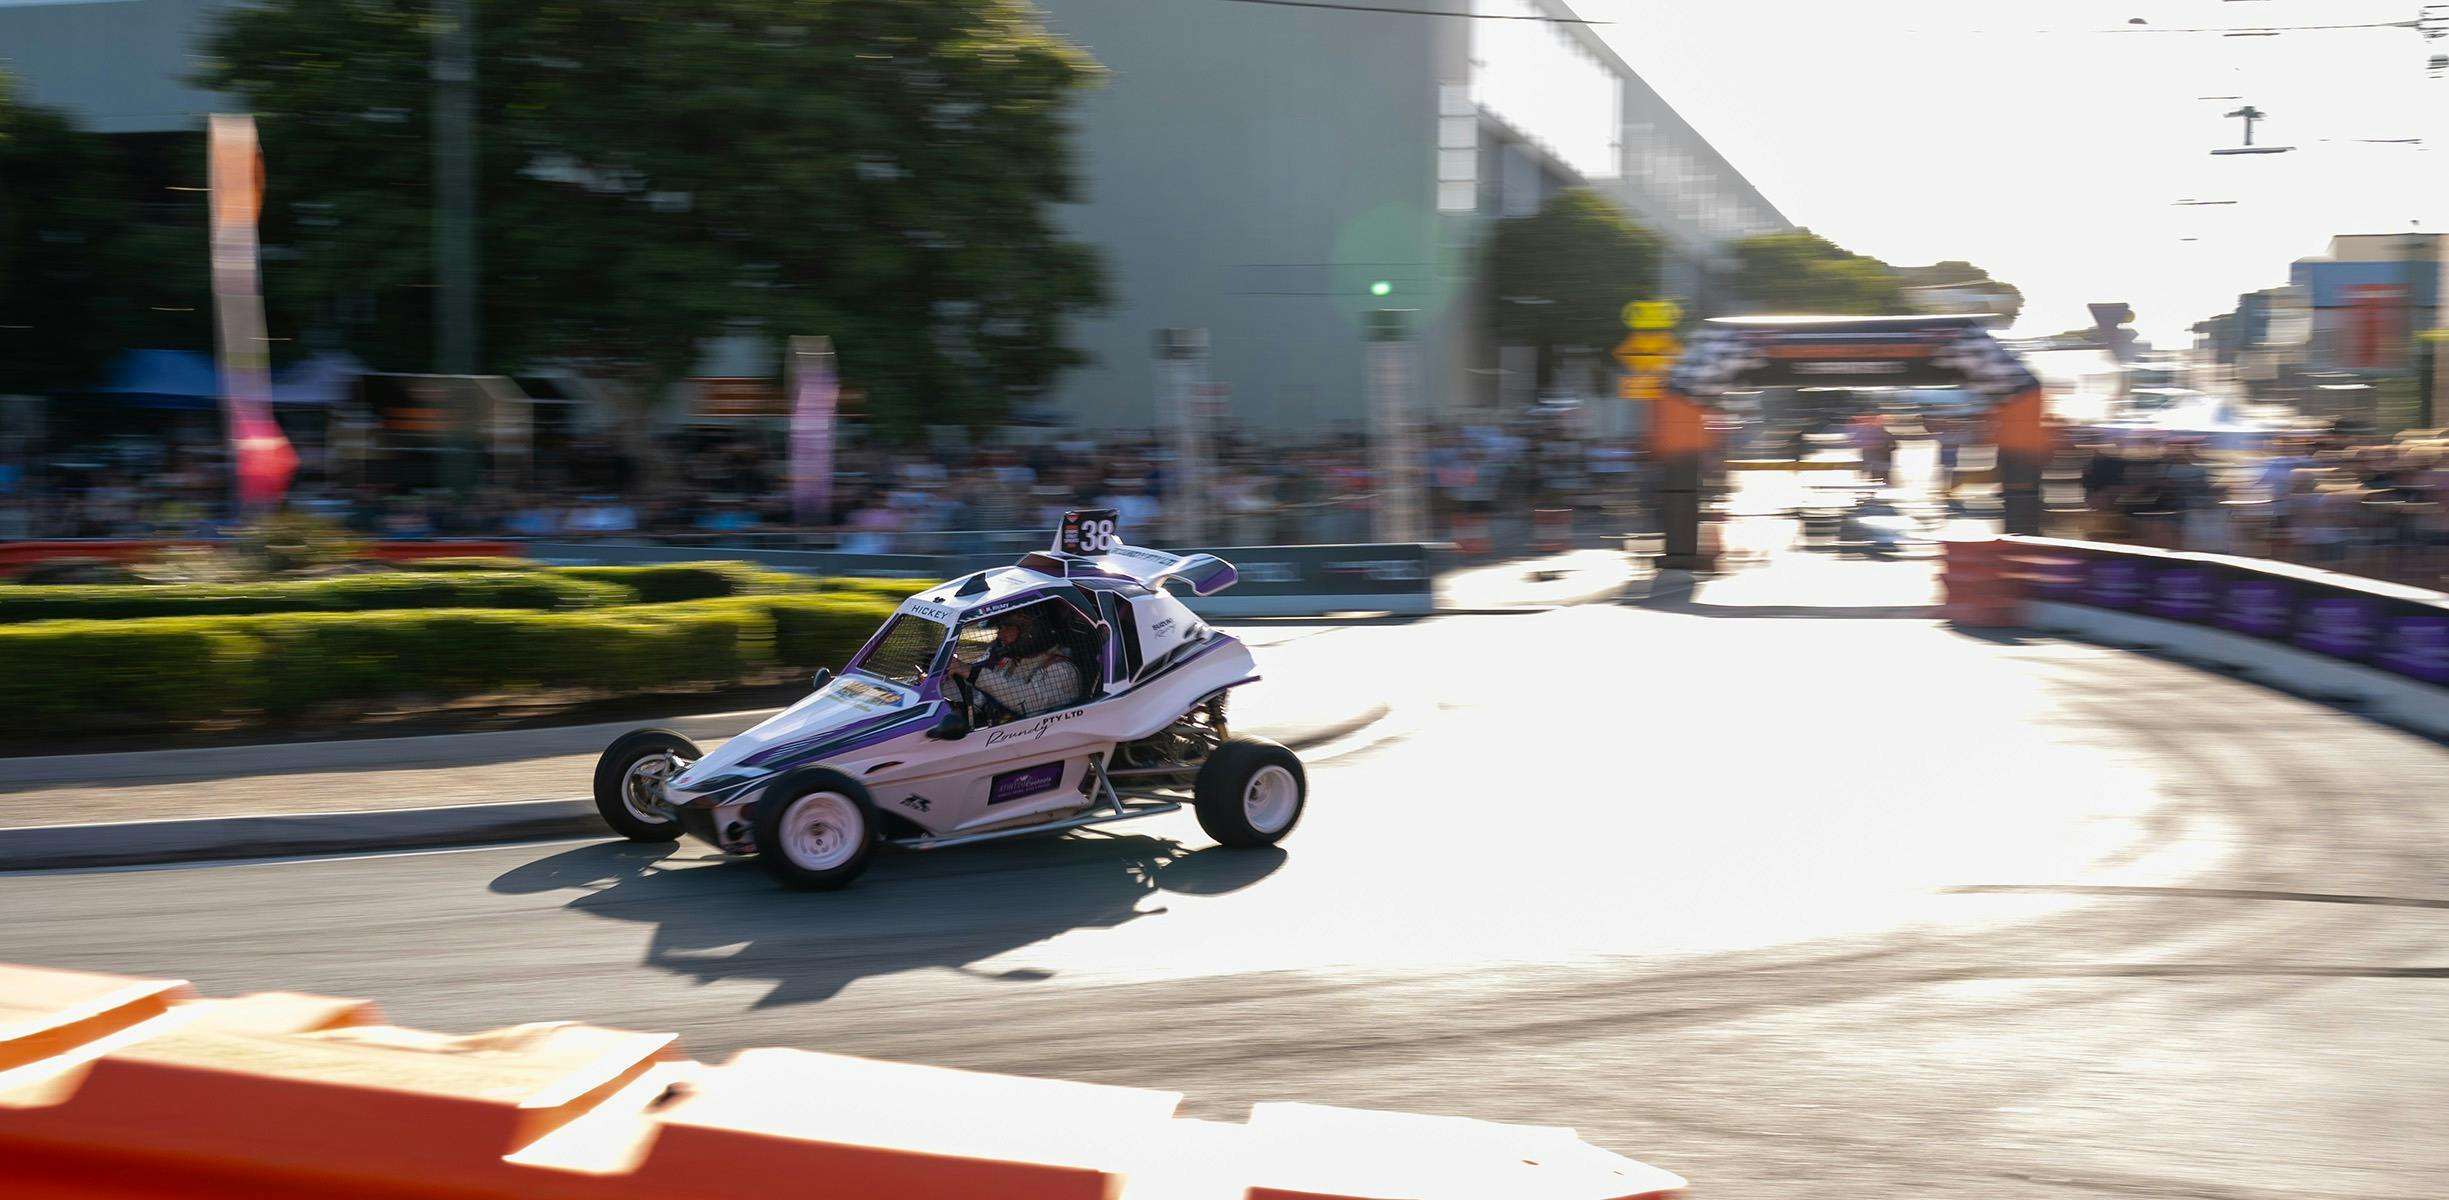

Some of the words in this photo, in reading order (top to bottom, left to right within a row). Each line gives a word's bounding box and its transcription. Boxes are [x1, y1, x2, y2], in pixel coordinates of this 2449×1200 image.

[1081, 519, 1114, 552] 38
[911, 604, 949, 620] HICKEY
[1043, 715, 1062, 726] PTY
[1064, 709, 1084, 720] LTD
[985, 721, 1050, 748] Roundy
